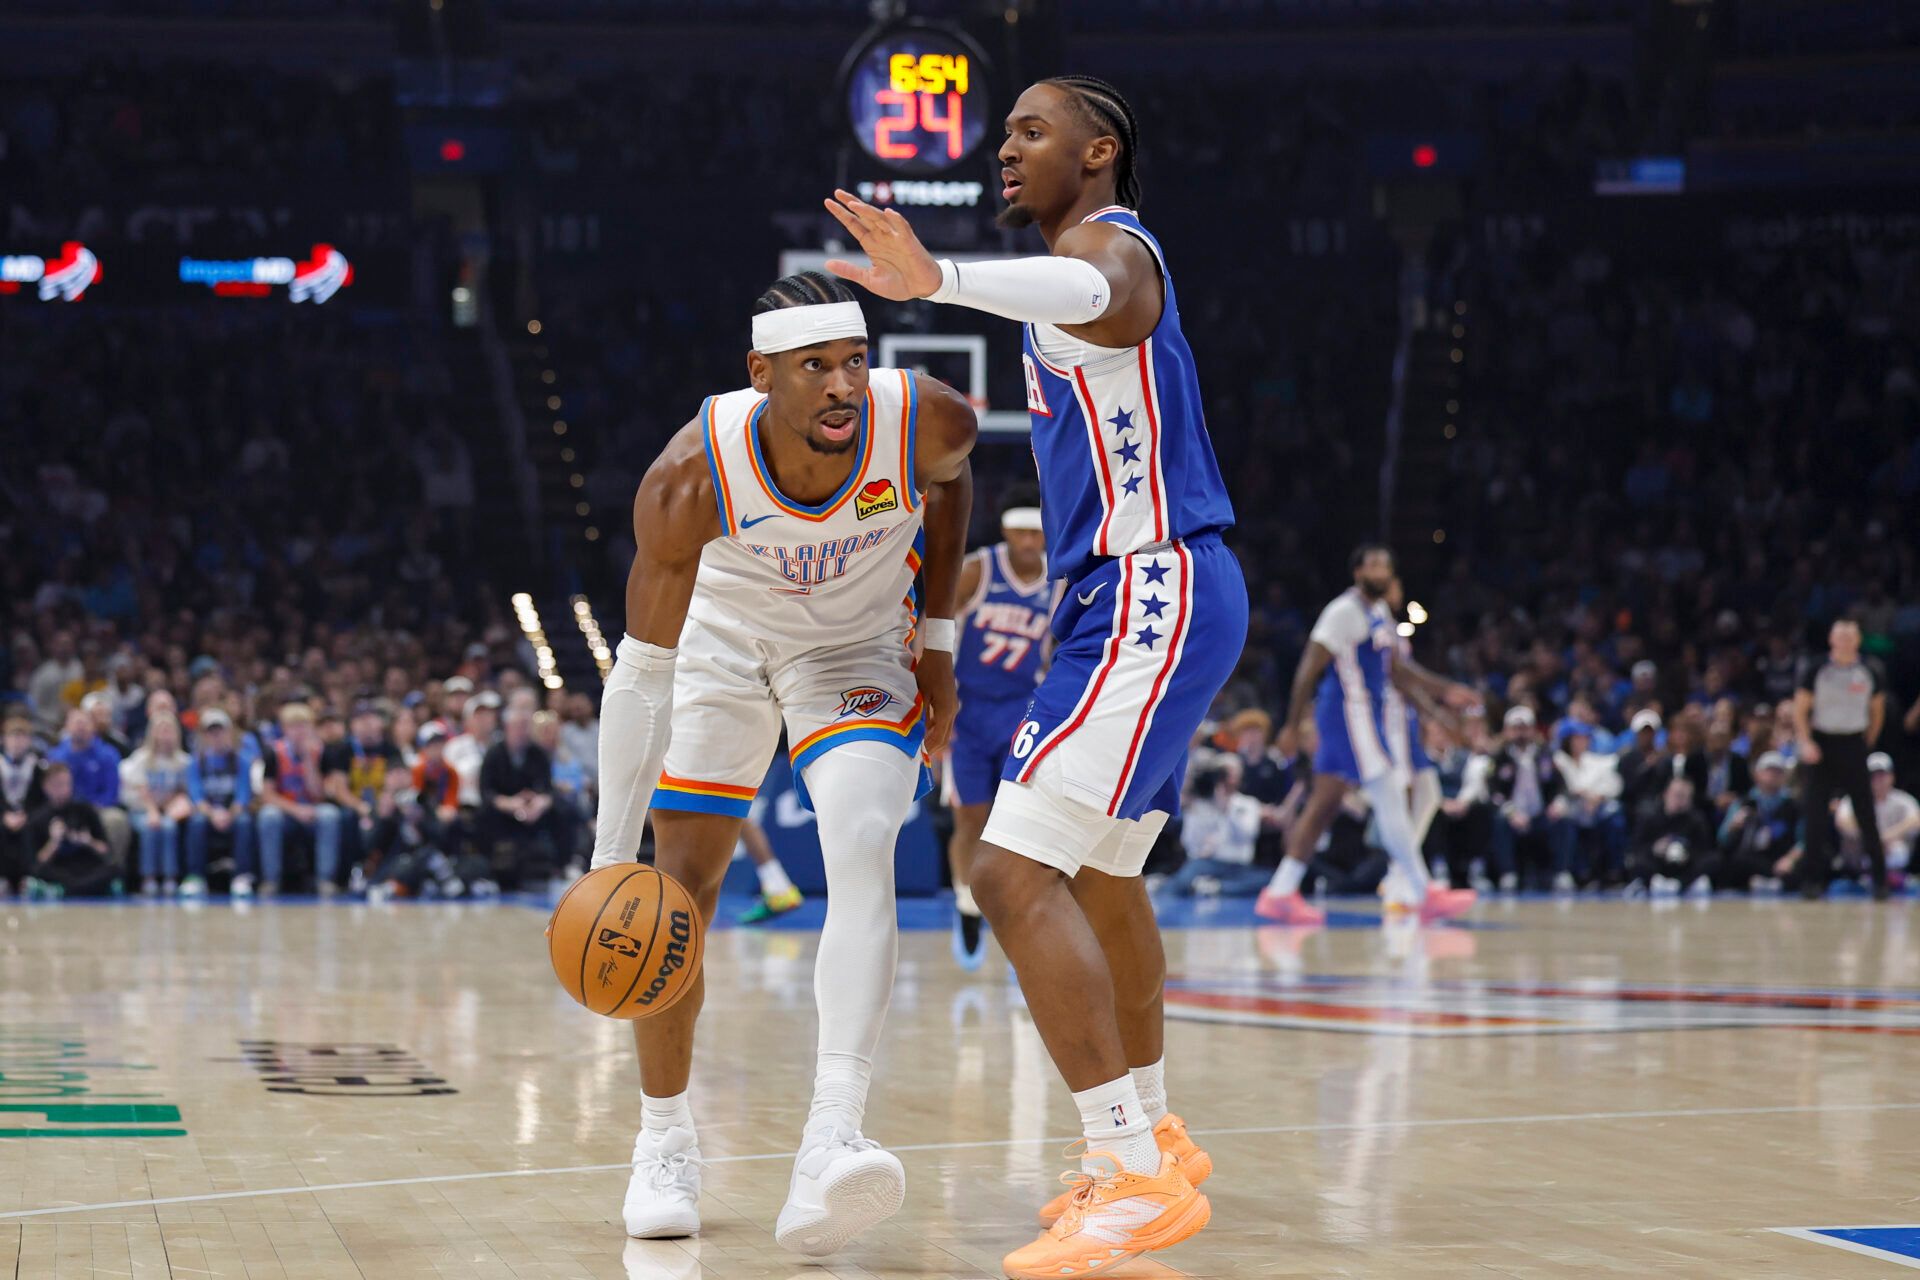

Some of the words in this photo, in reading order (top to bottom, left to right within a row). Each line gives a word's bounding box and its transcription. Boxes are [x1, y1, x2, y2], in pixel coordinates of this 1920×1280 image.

[875, 90, 963, 159] 24
[980, 632, 1032, 672] 77
[840, 693, 882, 716] OKC
[634, 908, 691, 1007] Wilson
